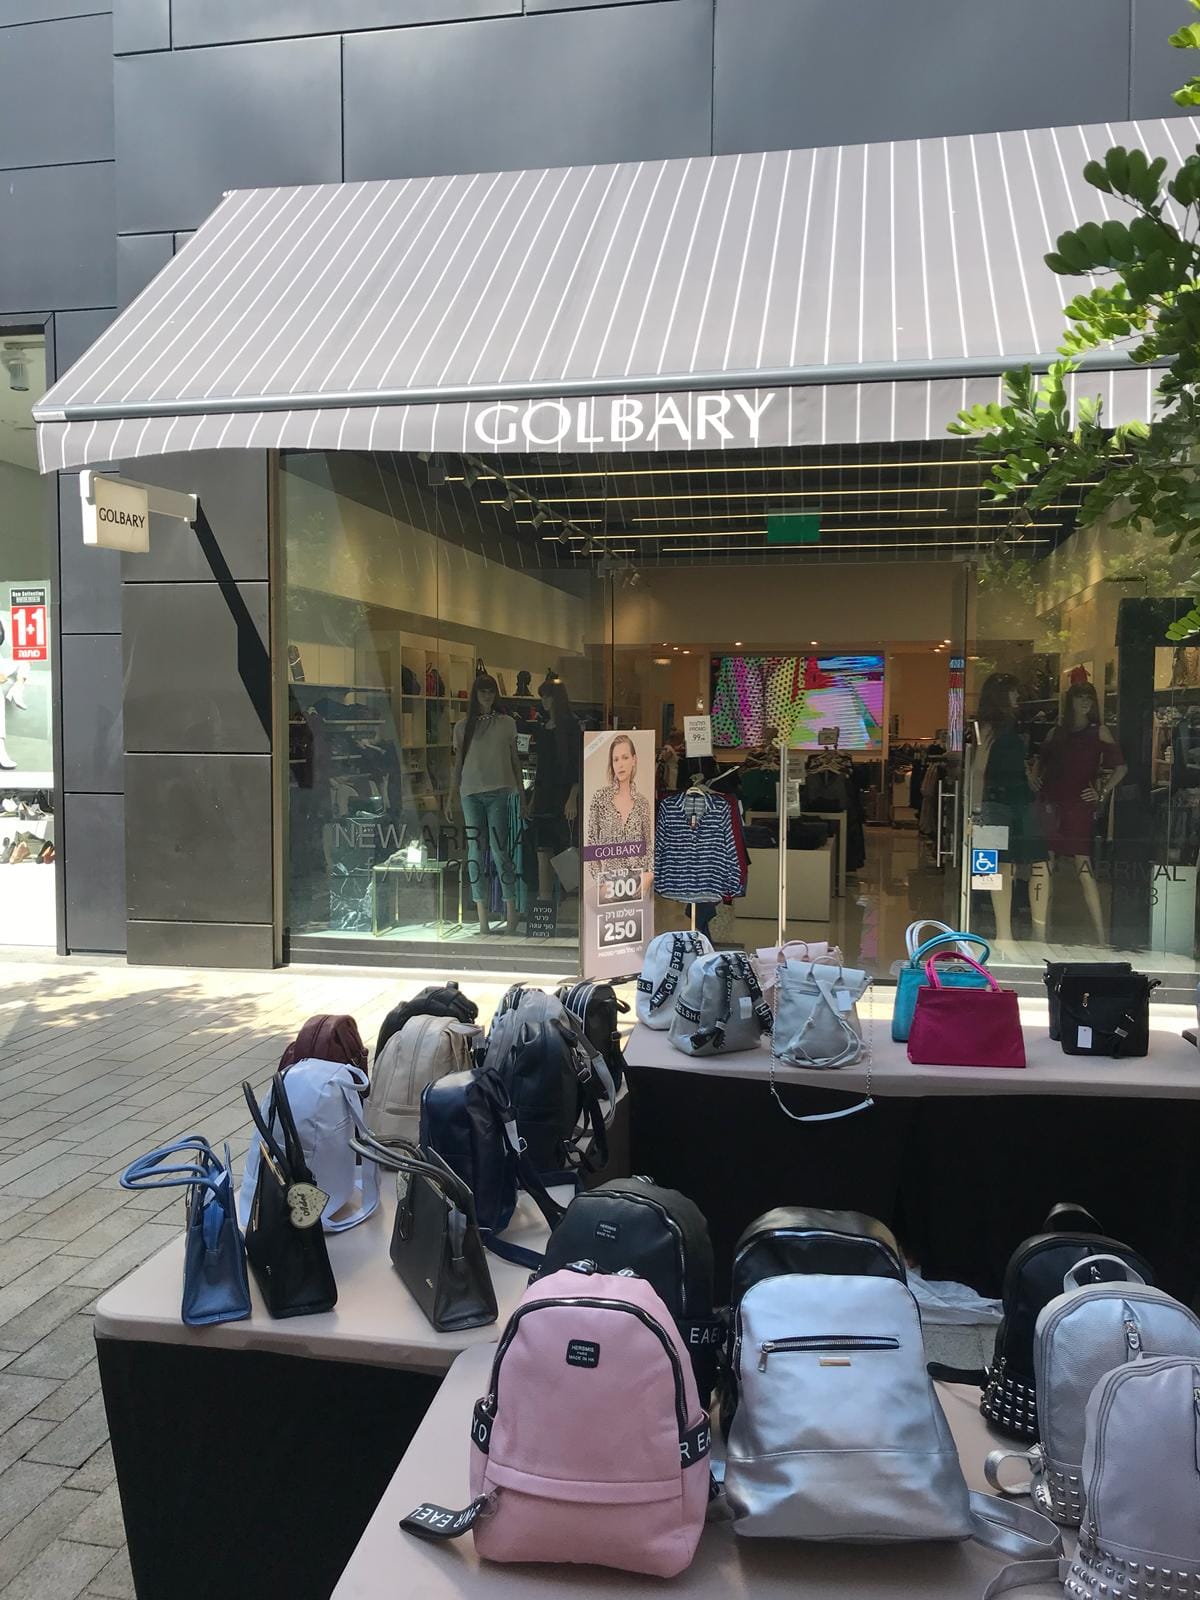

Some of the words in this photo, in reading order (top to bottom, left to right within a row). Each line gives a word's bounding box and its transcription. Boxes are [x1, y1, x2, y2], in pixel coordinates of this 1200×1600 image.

[474, 393, 776, 444] GOLBARY
[98, 507, 145, 528] GOLBARY
[335, 823, 407, 849] NEW
[594, 844, 642, 858] GOLBARY
[605, 878, 636, 898] 300
[604, 920, 637, 941] 250
